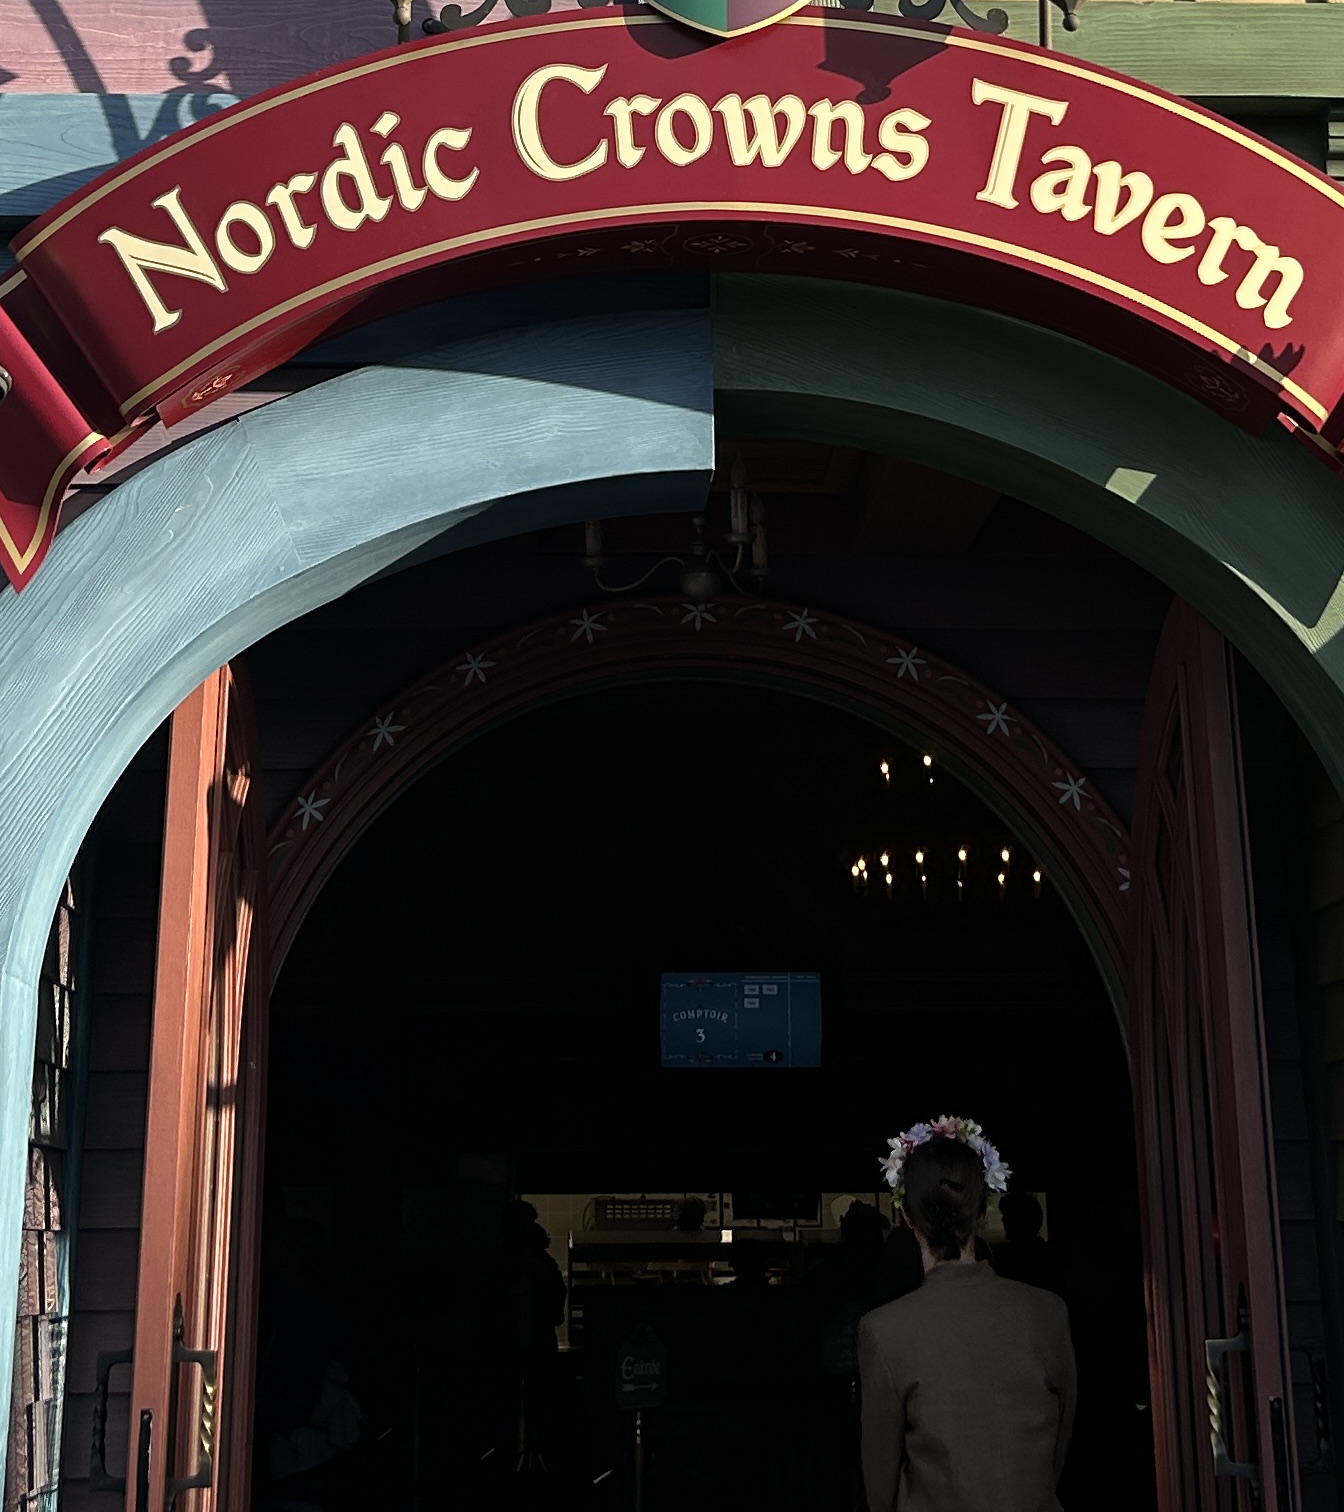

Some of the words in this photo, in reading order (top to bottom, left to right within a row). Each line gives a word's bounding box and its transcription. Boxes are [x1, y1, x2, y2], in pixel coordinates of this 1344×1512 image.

[97, 110, 481, 334] Nordic
[511, 62, 933, 183] Crowns
[970, 75, 1306, 330] Tavern
[672, 1009, 728, 1024] COMPTOIR
[695, 1028, 706, 1043] 3
